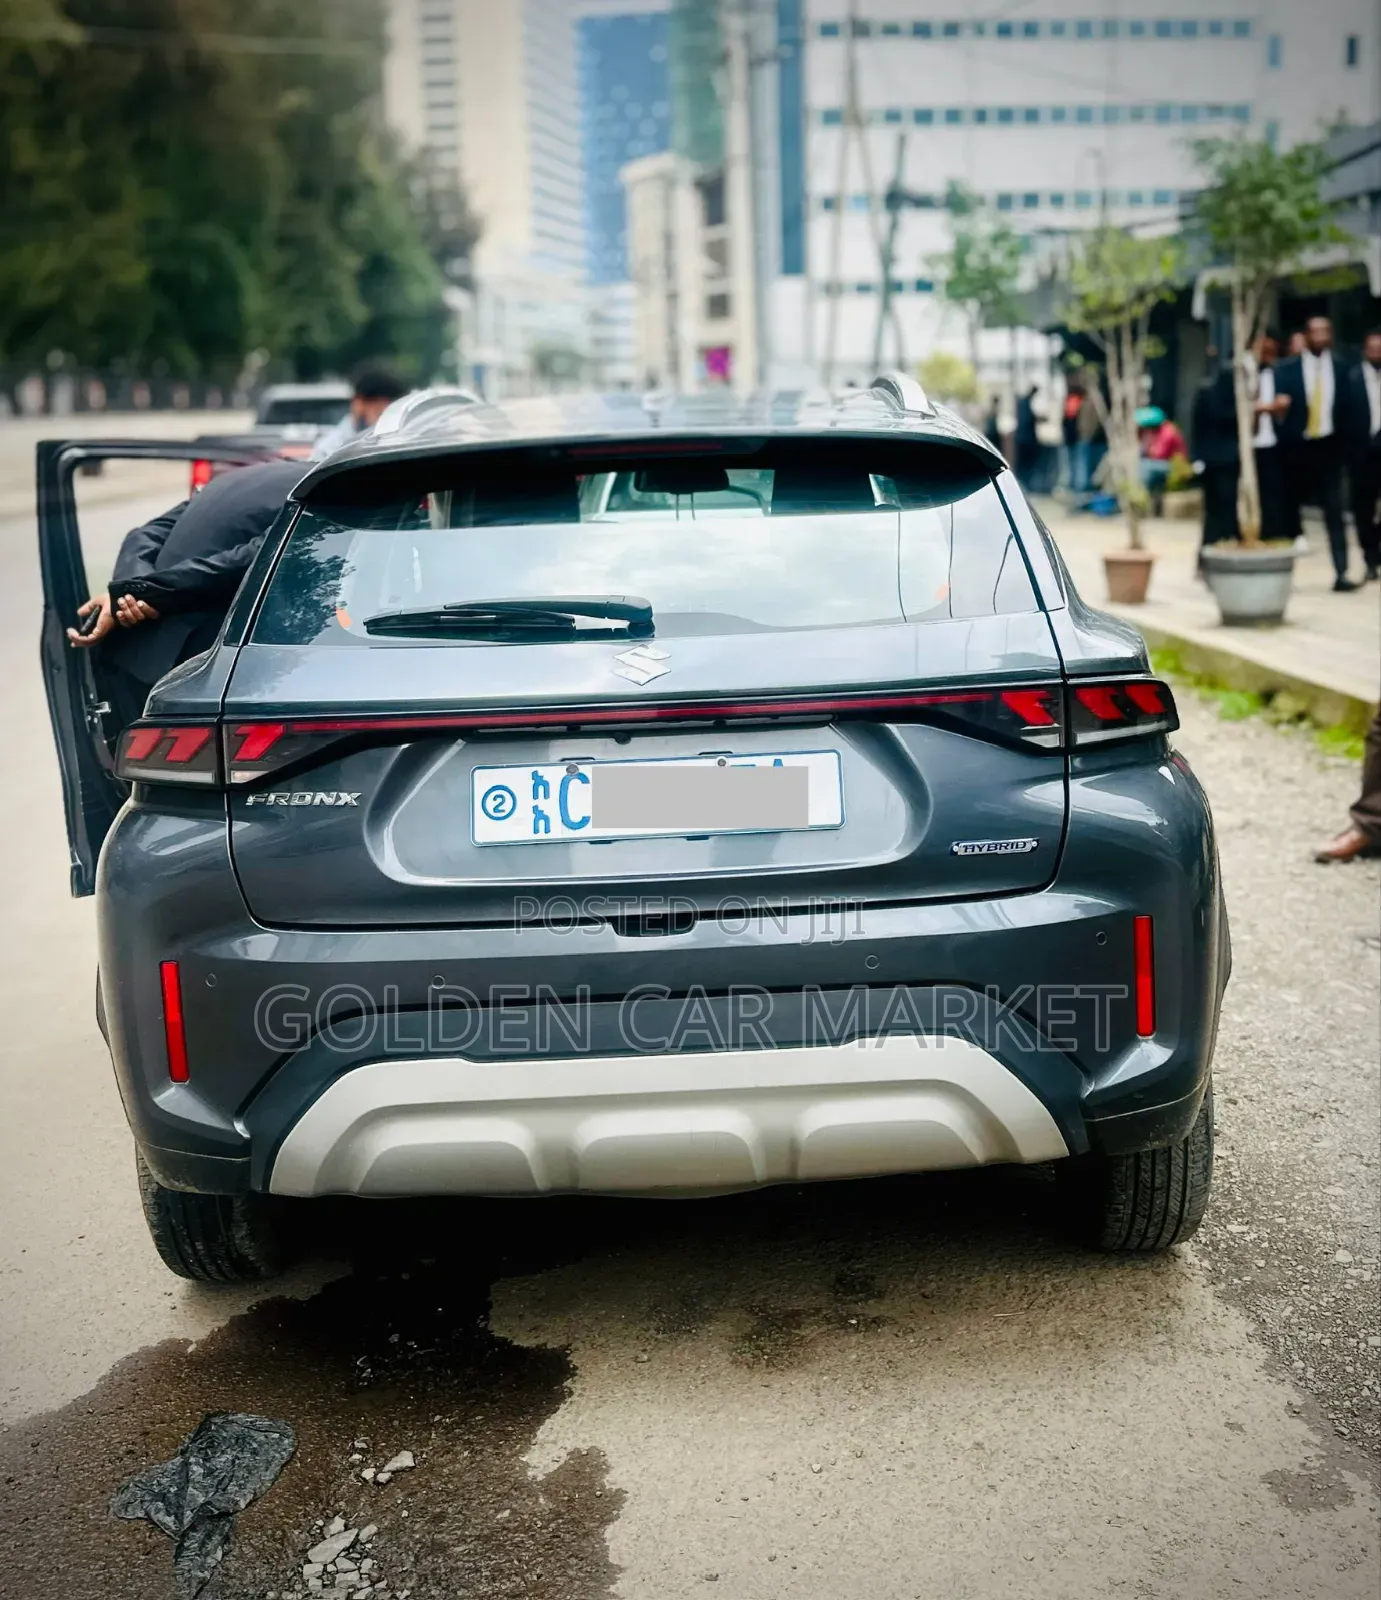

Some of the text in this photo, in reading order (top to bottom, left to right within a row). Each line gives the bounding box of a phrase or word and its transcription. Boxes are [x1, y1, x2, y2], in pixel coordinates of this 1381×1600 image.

[245, 791, 362, 806] FRONX
[492, 793, 506, 813] 2
[963, 841, 1027, 854] HYBRID
